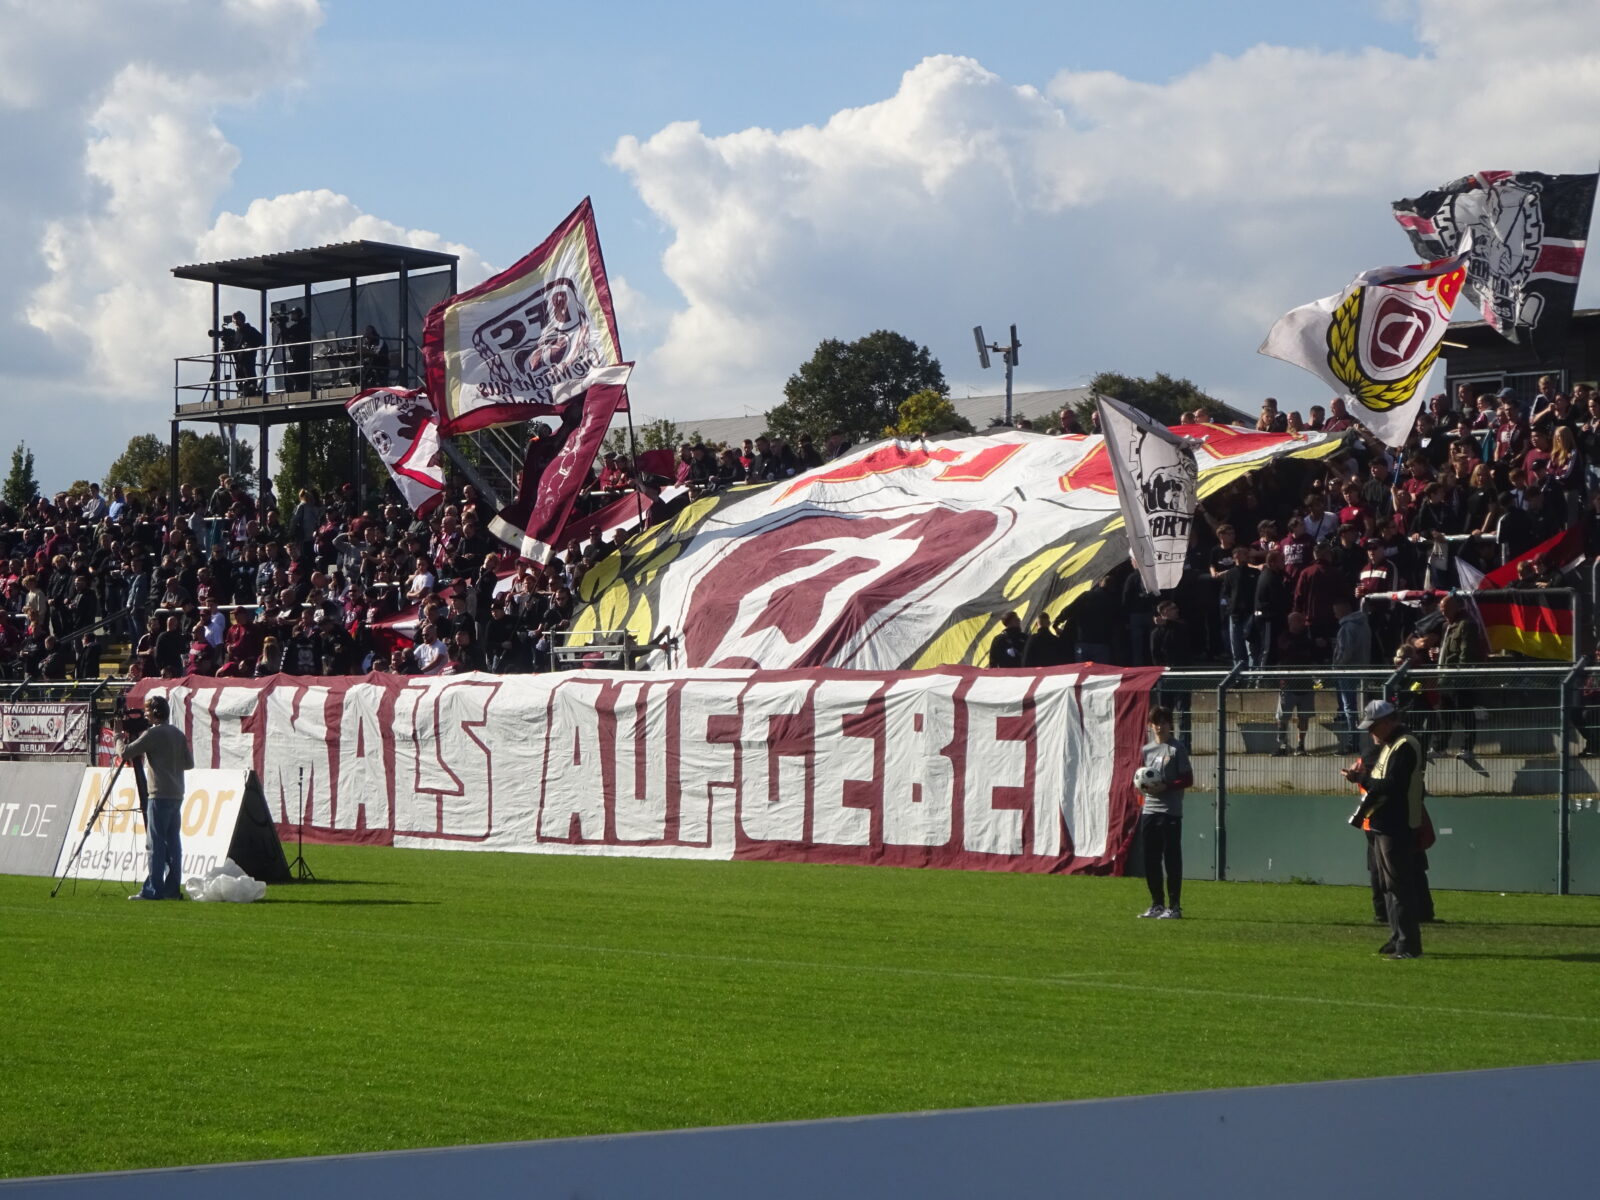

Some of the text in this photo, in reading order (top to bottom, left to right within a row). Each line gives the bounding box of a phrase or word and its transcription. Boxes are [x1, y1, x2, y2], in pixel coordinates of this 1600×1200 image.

[3, 705, 65, 714] DYNAMO FAMILIE
[20, 743, 46, 753] BERLIN
[538, 673, 1122, 857] AUFGEBEN
